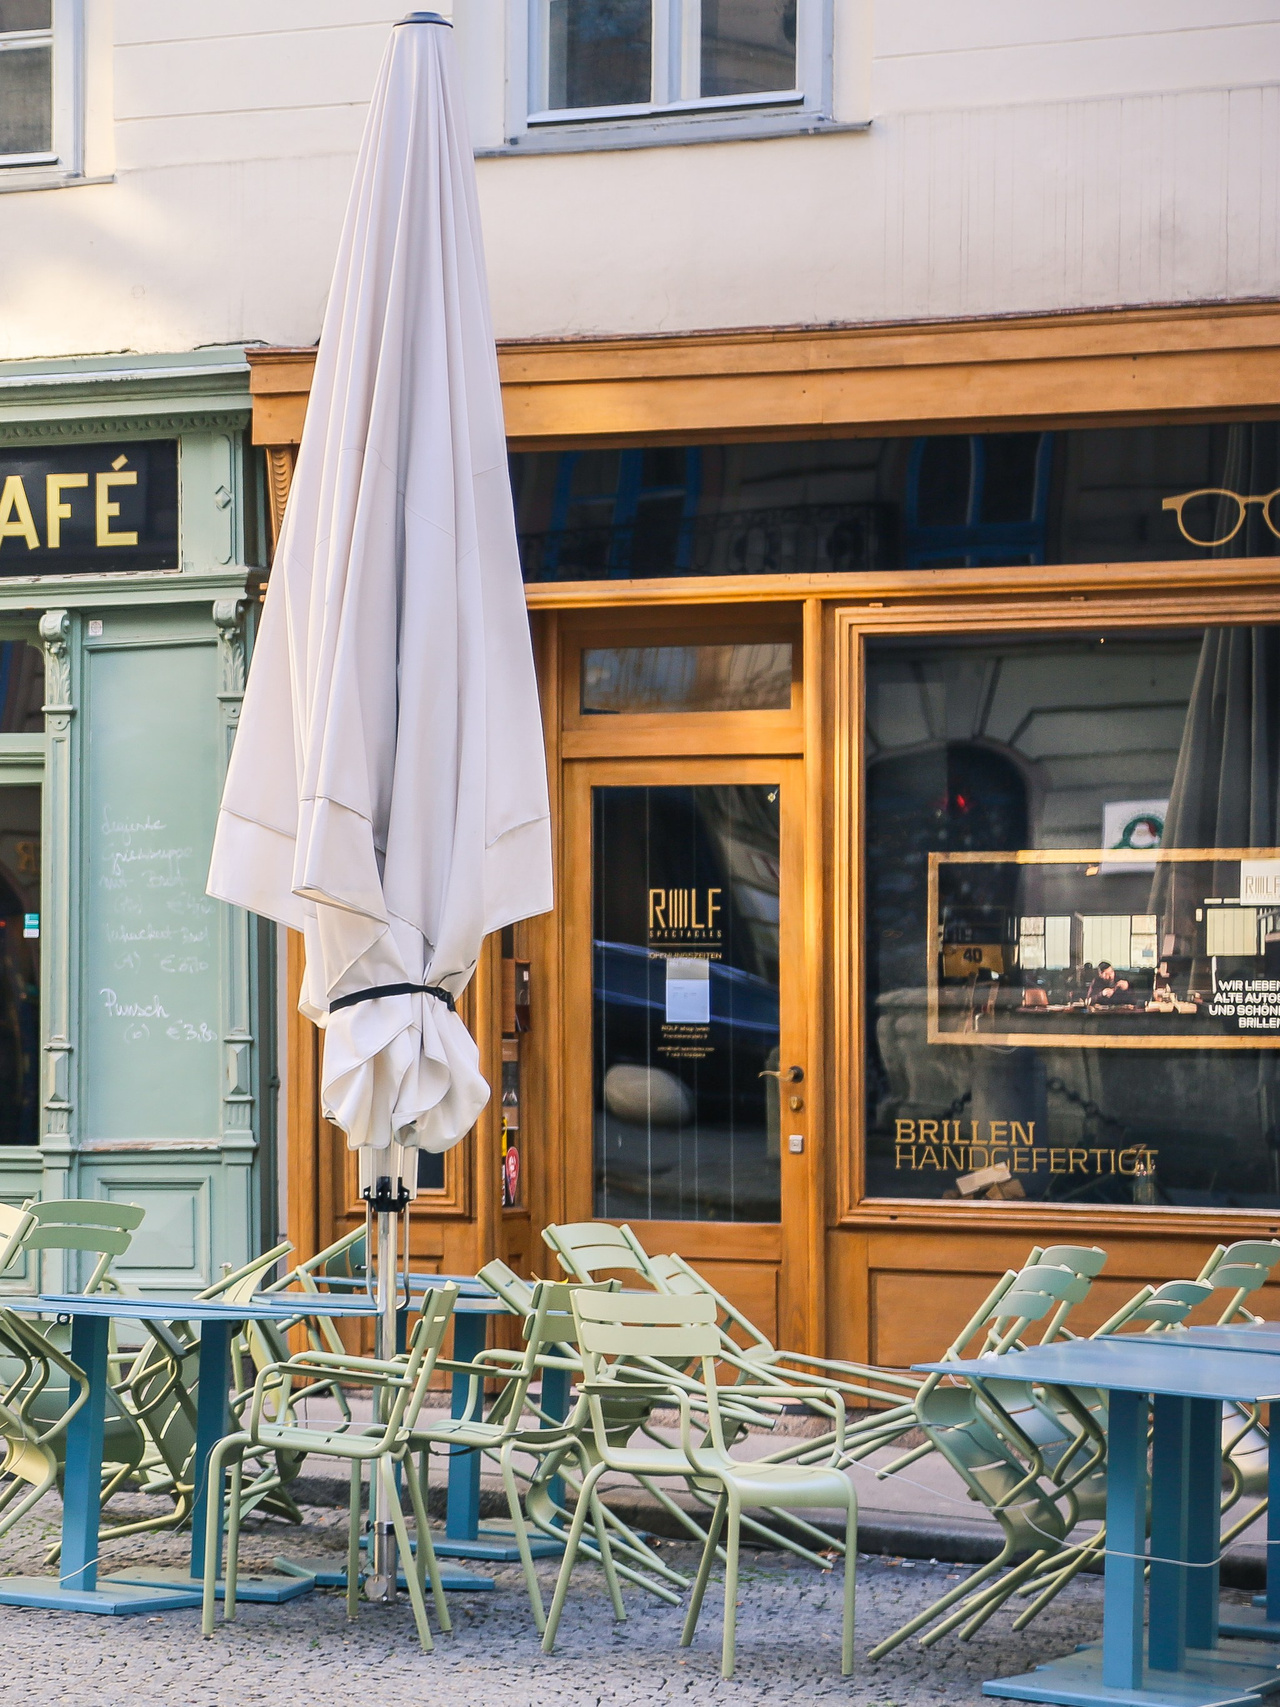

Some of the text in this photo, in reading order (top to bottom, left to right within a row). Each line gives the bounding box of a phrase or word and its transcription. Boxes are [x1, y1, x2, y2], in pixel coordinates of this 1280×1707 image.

[963, 947, 983, 963] 40
[1218, 979, 1244, 992] WIR
[99, 988, 170, 1018] Punsch
[1213, 992, 1243, 1004] ALTE
[1208, 1002, 1280, 1016] UND SCHÖN
[894, 1119, 1035, 1146] BRILLEN
[894, 1145, 1159, 1176] HANDGEFERTIGT
